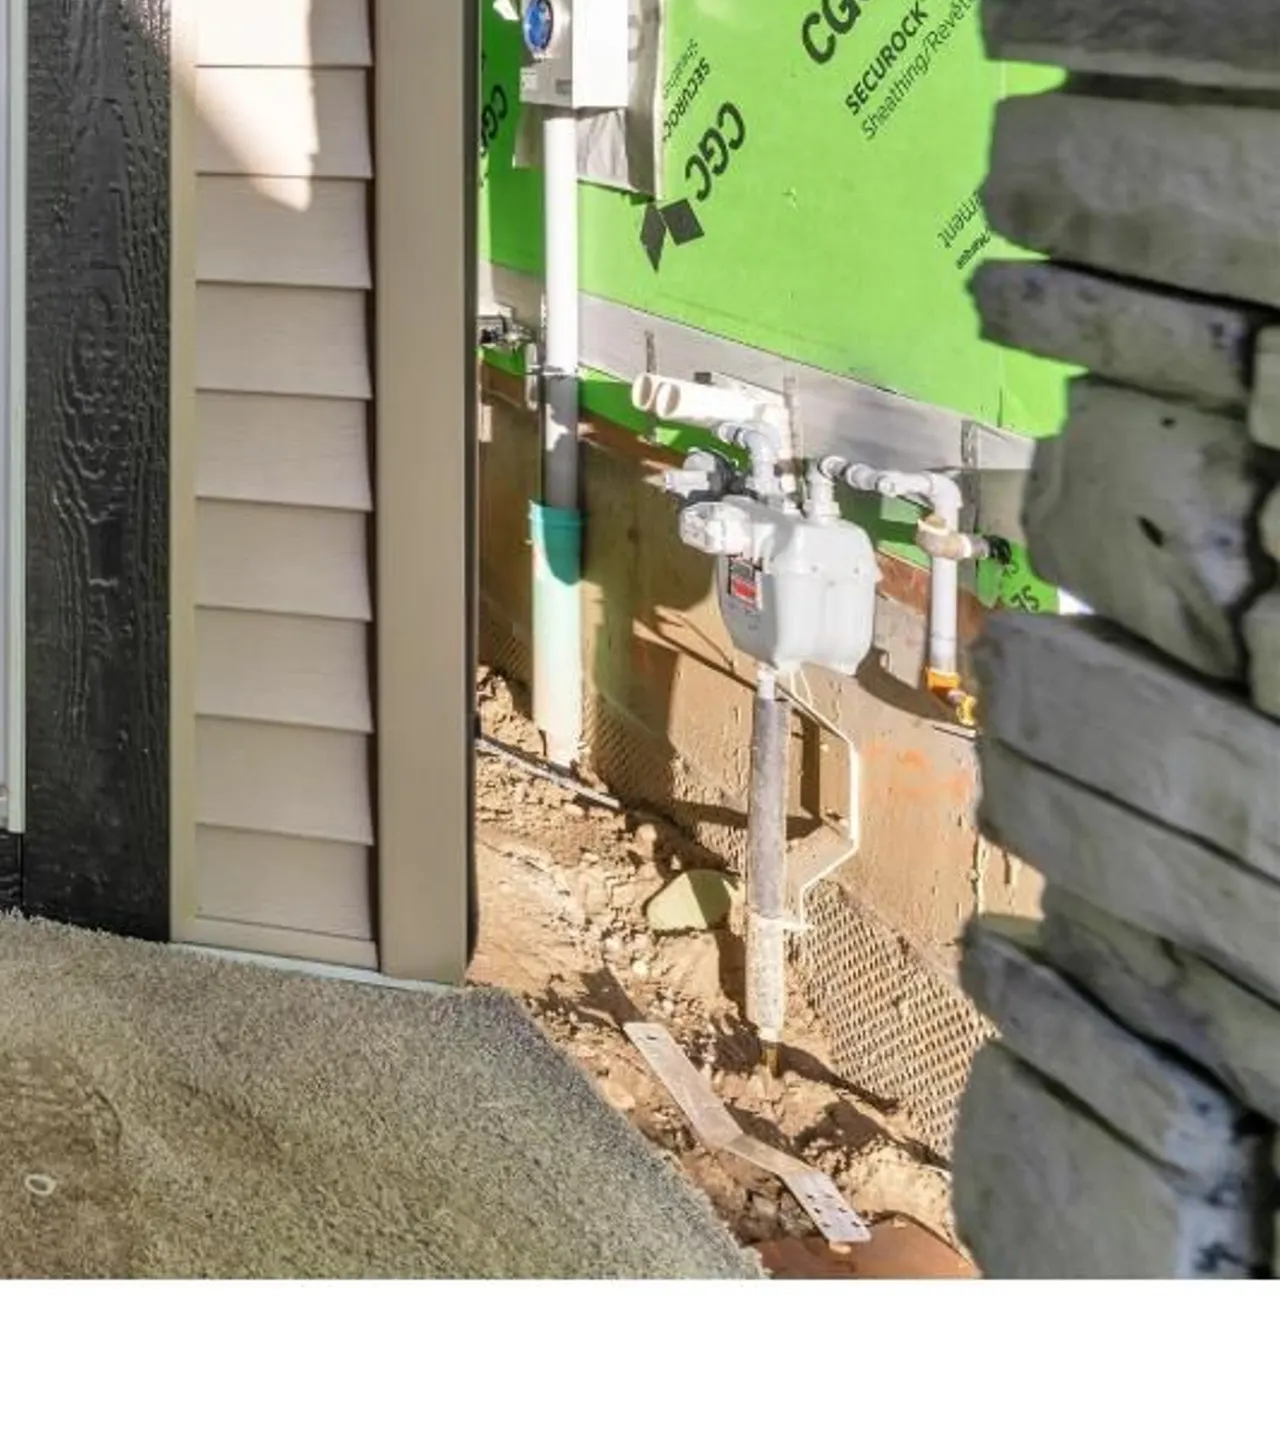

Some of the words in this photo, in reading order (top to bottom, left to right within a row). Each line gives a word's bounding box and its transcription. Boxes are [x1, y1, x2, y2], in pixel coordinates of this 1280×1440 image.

[662, 57, 710, 142] SECUROC
[845, 0, 929, 116] SECUROCK
[685, 101, 745, 202] CGC
